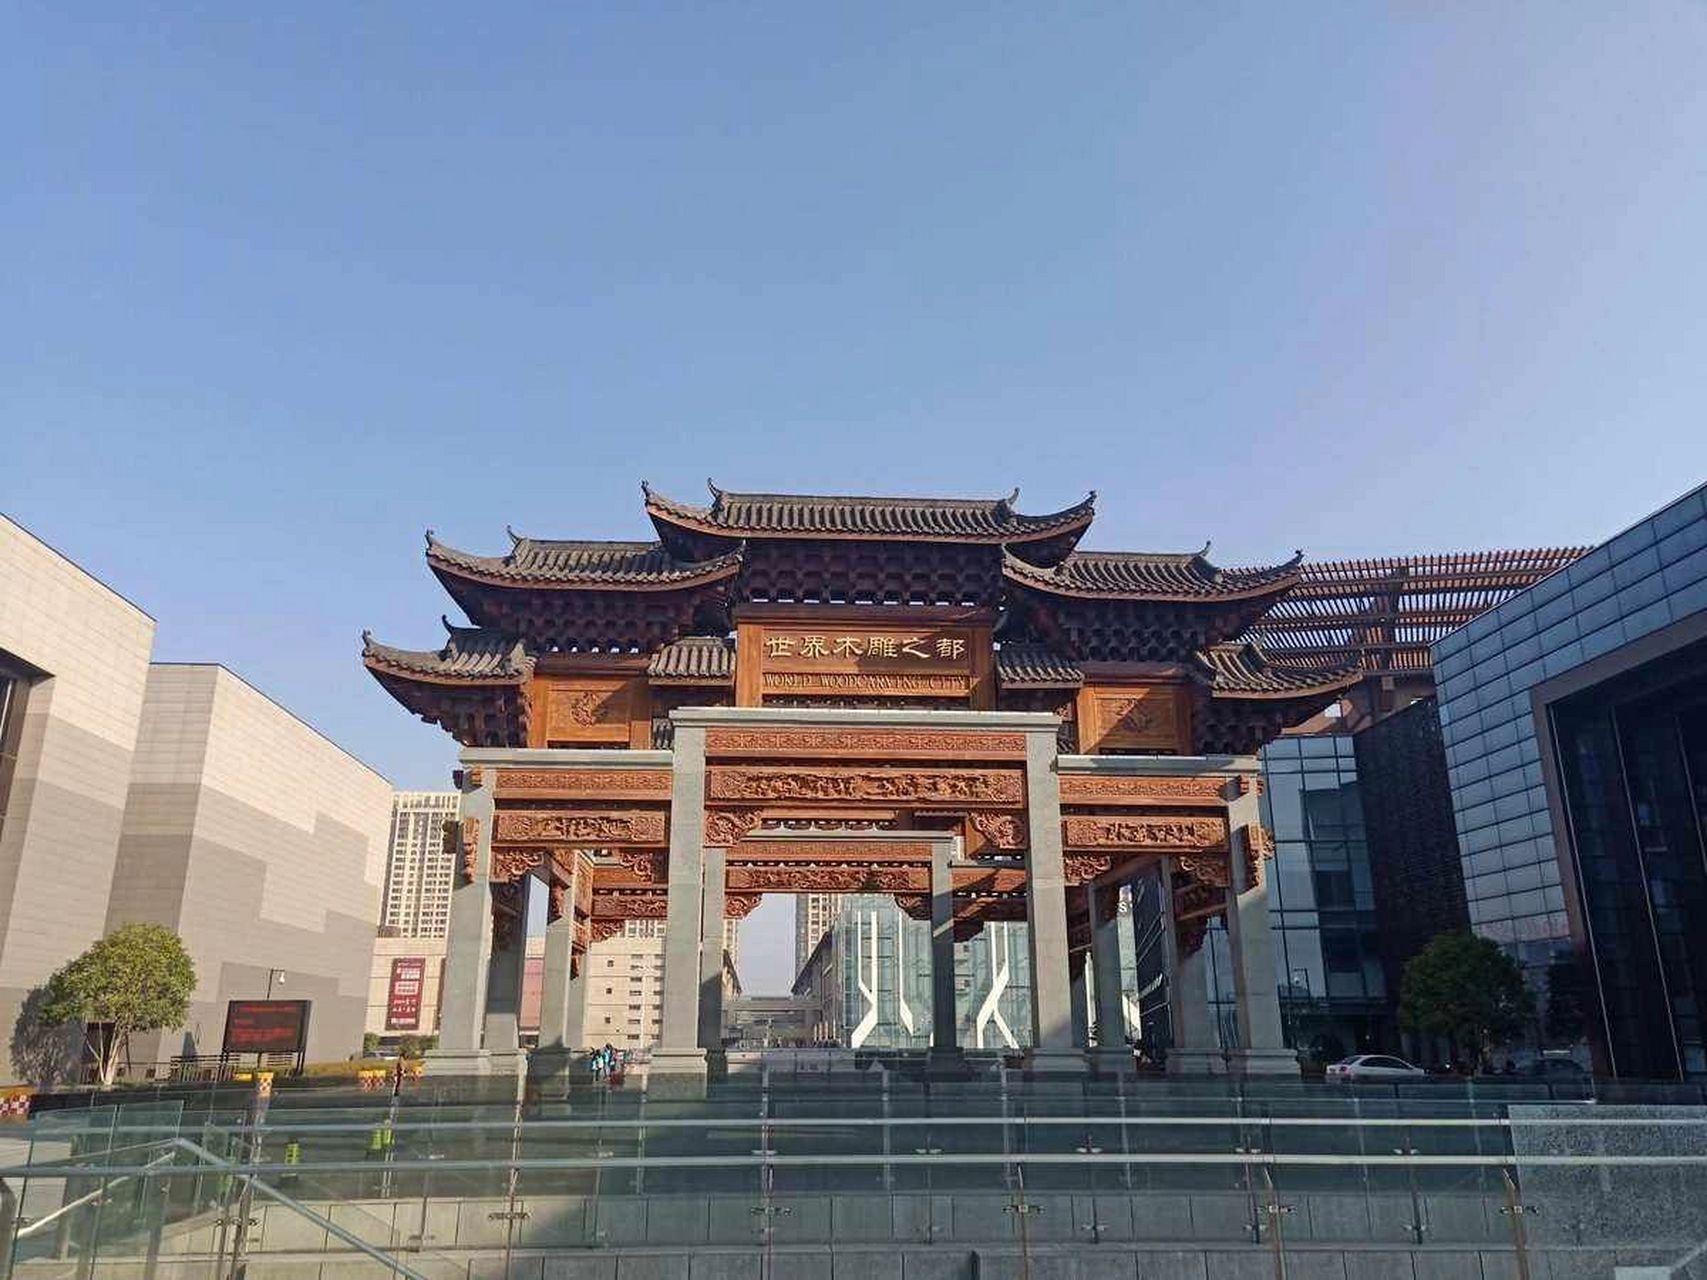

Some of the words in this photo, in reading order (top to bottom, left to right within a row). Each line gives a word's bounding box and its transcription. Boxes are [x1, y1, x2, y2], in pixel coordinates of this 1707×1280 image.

[766, 636, 965, 660] 世界木雕之都
[764, 674, 811, 687] WORLD
[929, 676, 965, 689] CITY
